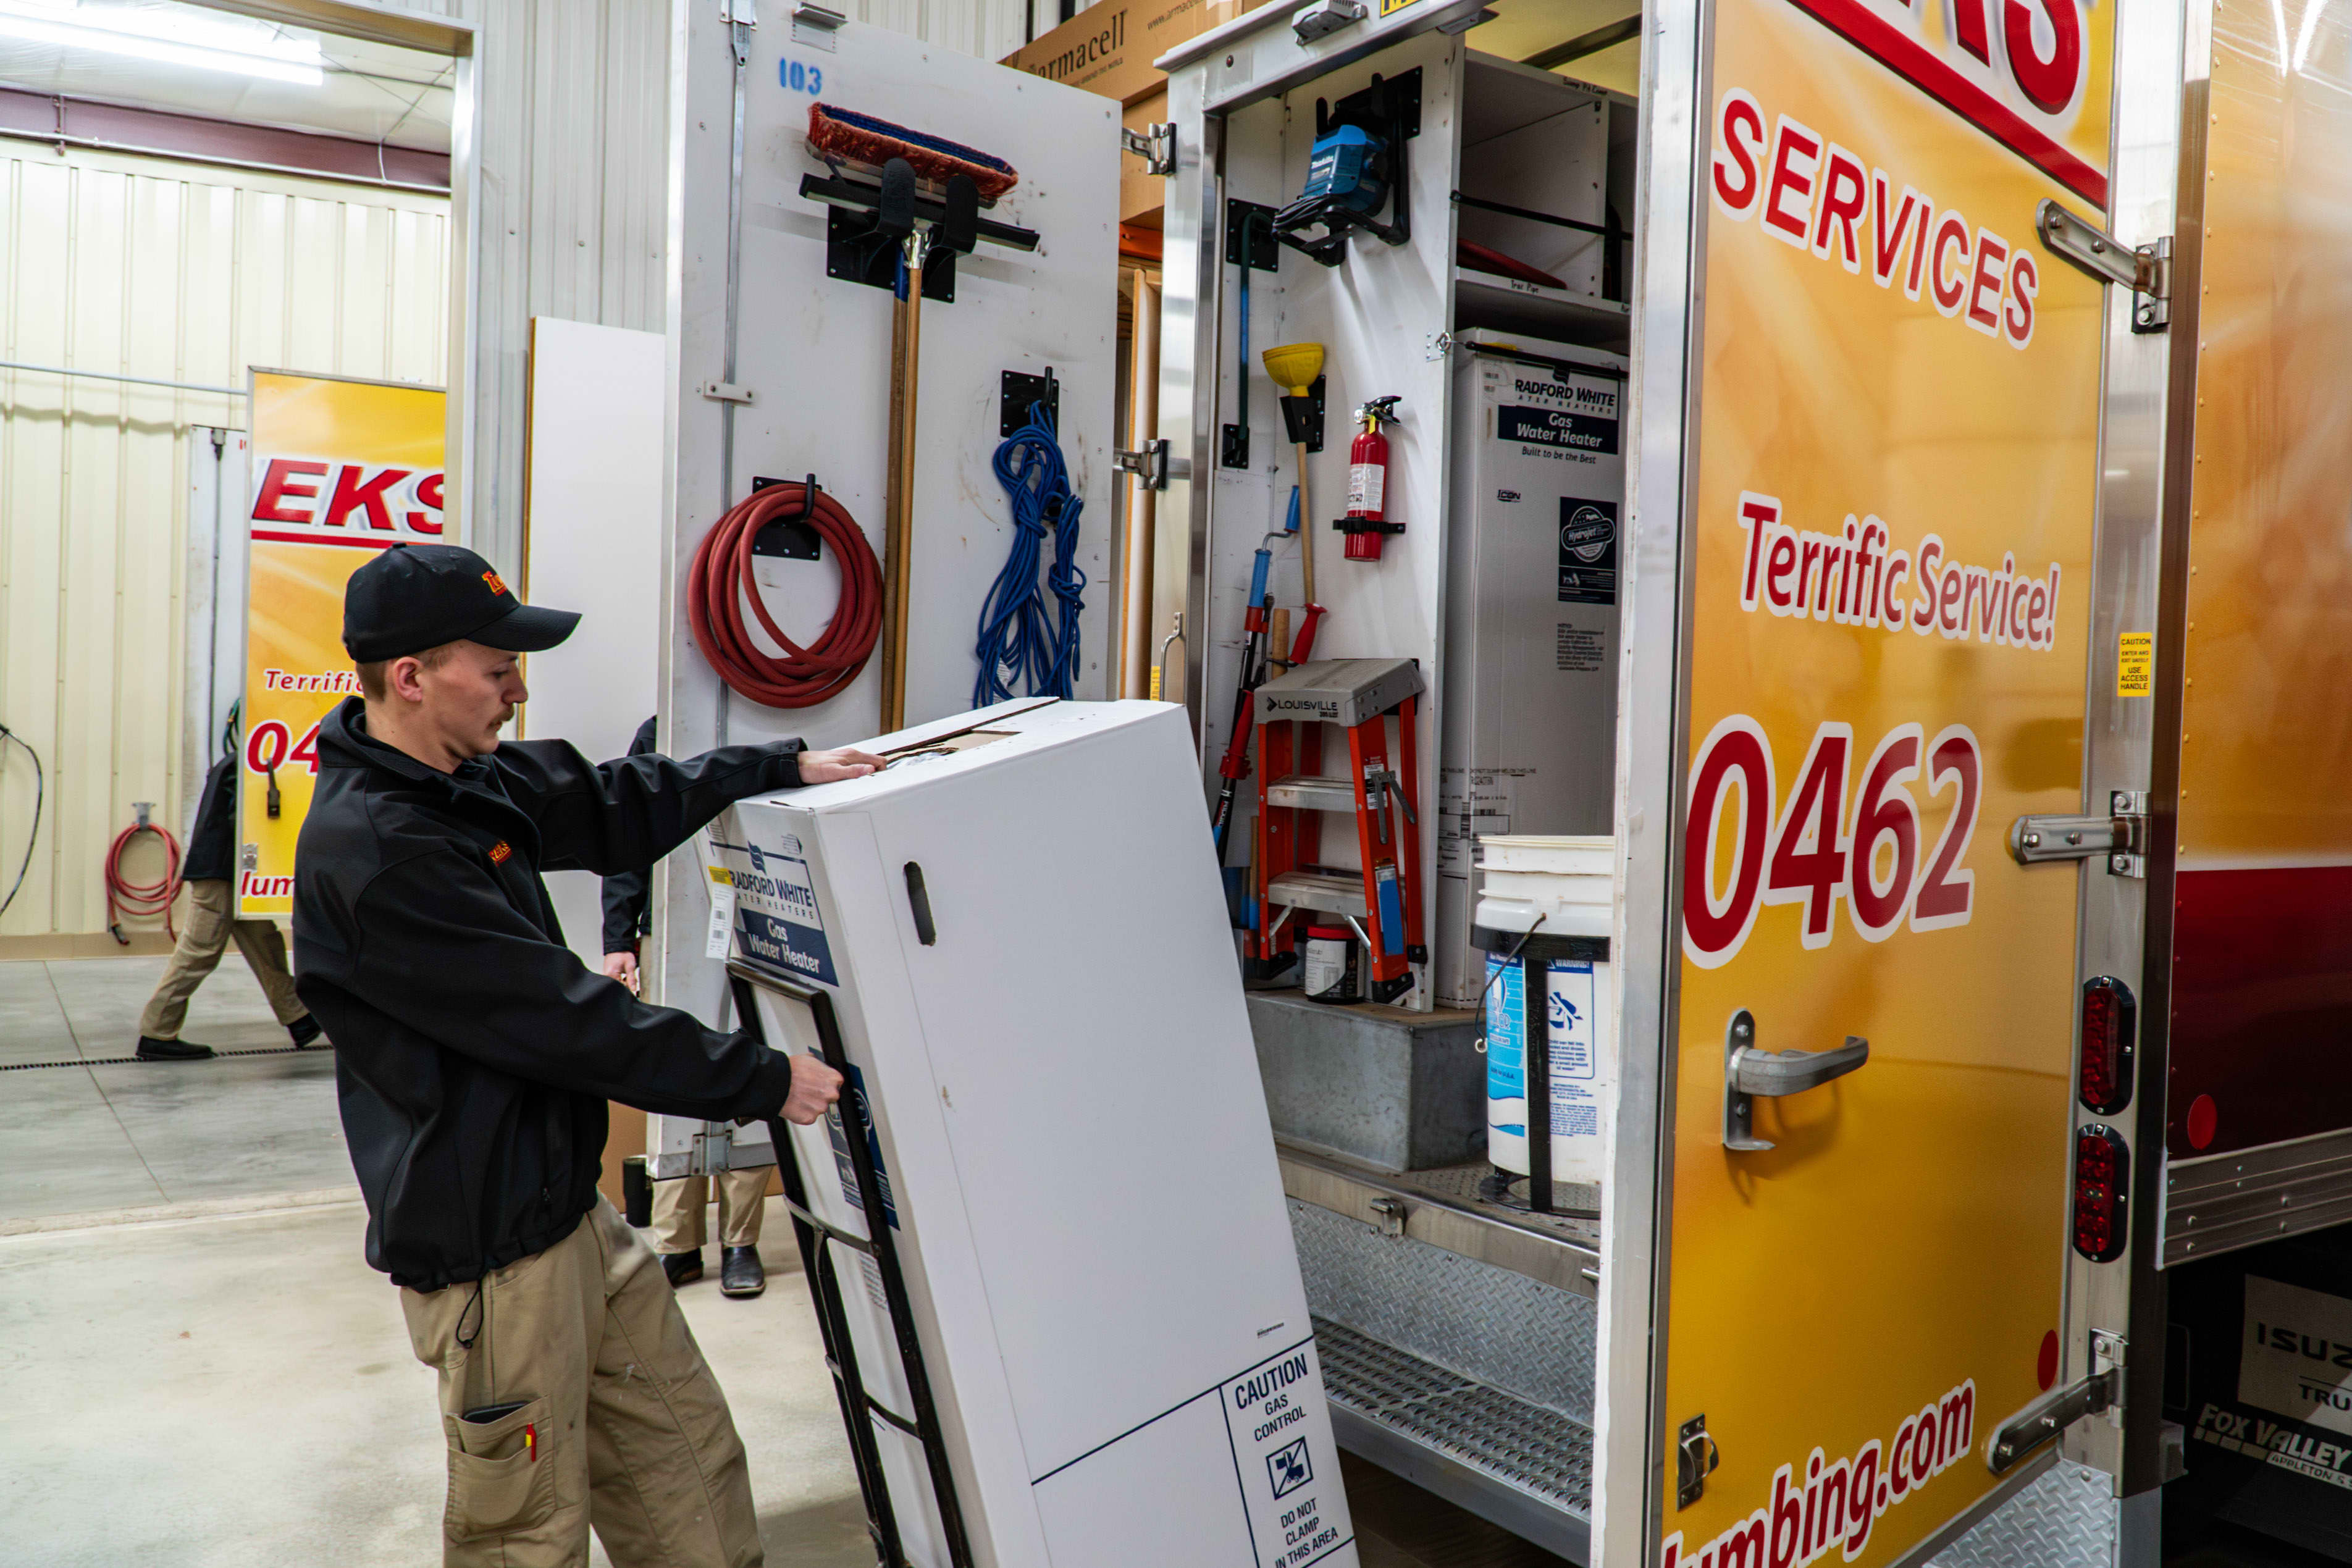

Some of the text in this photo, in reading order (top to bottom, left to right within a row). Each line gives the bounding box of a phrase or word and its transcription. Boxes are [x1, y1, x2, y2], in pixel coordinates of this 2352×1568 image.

[778, 57, 823, 96] 103
[1713, 99, 2038, 342] SERVICES
[1558, 401, 1612, 414] HEATERS
[1576, 387, 1615, 406] WHITE
[1548, 413, 1573, 428] Gas
[1517, 423, 1603, 448] Water Heater
[1522, 446, 1597, 464] Built to be the Best
[1742, 502, 2059, 645] Terrific Service!
[1278, 699, 1338, 711] LOUISVILLE
[1684, 730, 1979, 954] 0462
[775, 878, 813, 907] WHITE
[767, 899, 813, 920] HEATERS
[767, 918, 788, 941] Gas
[748, 933, 820, 973] Water Heater
[1556, 959, 1590, 969] WARNING!
[1235, 1353, 1308, 1410] CAUTION
[1264, 1394, 1289, 1416] GAS
[2298, 1384, 2351, 1411] TRU
[1254, 1405, 1307, 1442] CONTROL
[2198, 1402, 2352, 1470] FOX VALLEY
[2271, 1454, 2332, 1481] APPLETON
[1280, 1497, 1317, 1529] DO NOT
[1285, 1517, 1320, 1546] CLAMP
[1287, 1545, 1312, 1567] THIS
[1312, 1527, 1338, 1553] AREA
